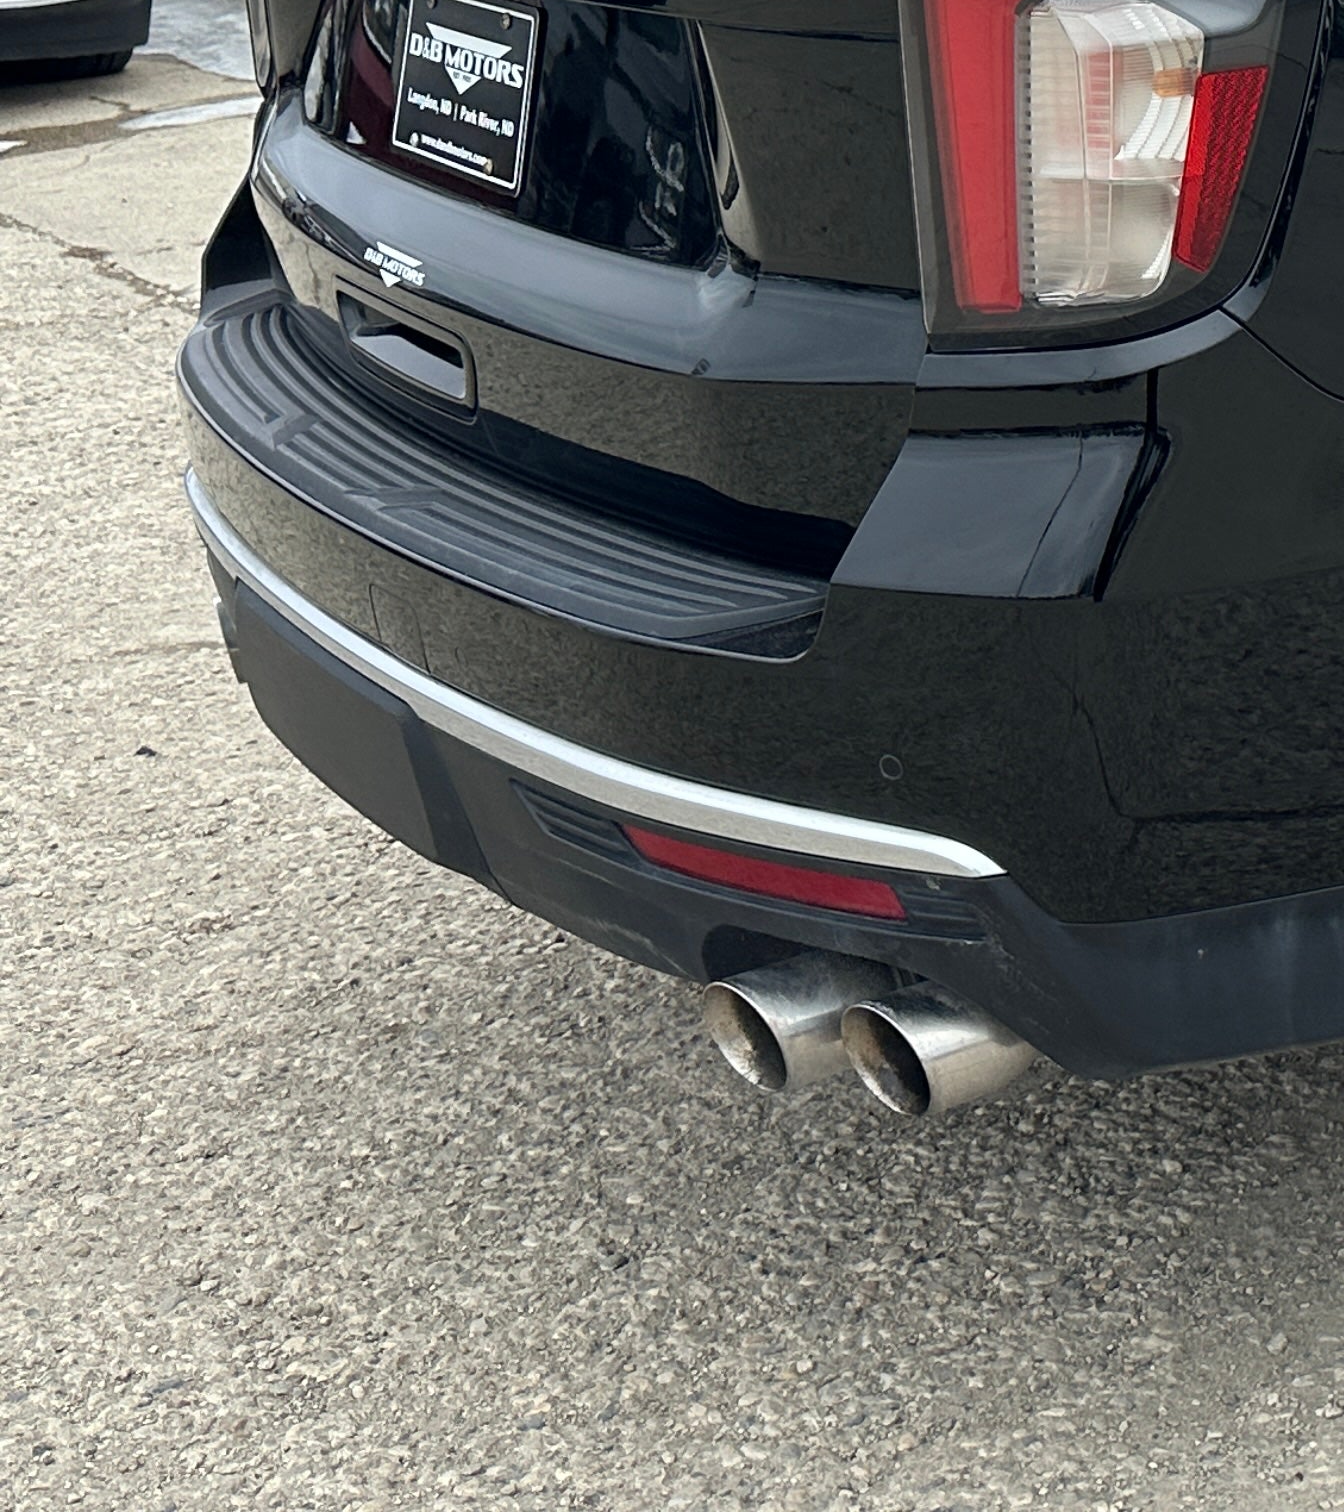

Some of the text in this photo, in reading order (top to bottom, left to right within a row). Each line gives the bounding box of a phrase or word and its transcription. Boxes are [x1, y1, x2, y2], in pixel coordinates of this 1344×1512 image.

[409, 32, 525, 88] D&B MOTORS
[382, 256, 426, 287] MOTORS
